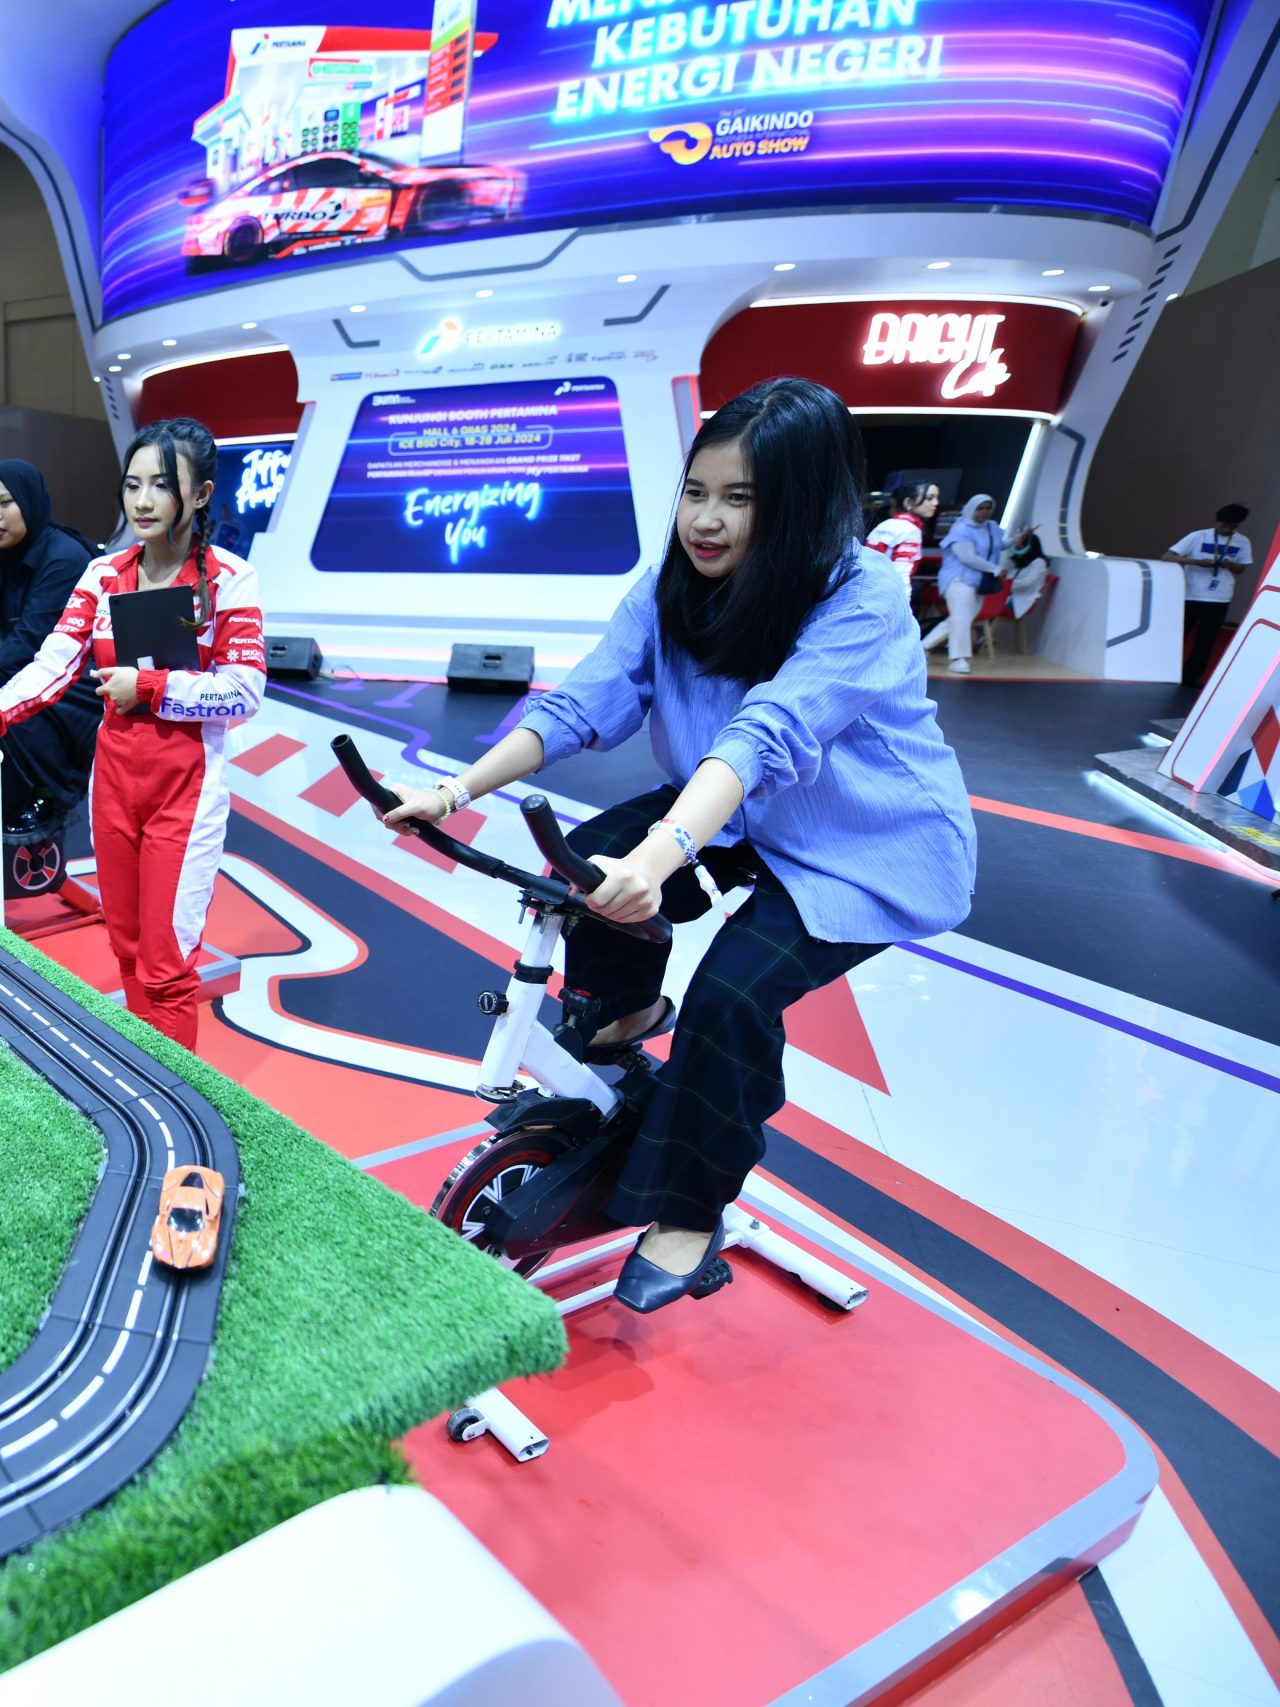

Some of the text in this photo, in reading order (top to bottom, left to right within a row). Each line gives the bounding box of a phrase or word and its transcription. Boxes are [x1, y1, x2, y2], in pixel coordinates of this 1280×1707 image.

[592, 0, 917, 67] KEBUTUHAN
[552, 34, 943, 122] ENERGI NEGERI
[716, 110, 814, 136] GAIKINDO
[708, 135, 809, 160] AUTO SHOW
[863, 313, 1006, 365] BRIGHT
[448, 409, 489, 421] BOOTH
[489, 405, 558, 418] PERTAMINA
[423, 426, 449, 436] HALL
[491, 423, 517, 433] 2024
[514, 433, 541, 444] 2024
[404, 480, 540, 526] Energizing
[445, 517, 486, 564] You
[161, 697, 245, 717] Fastron
[200, 689, 242, 701] PERTAMINA
